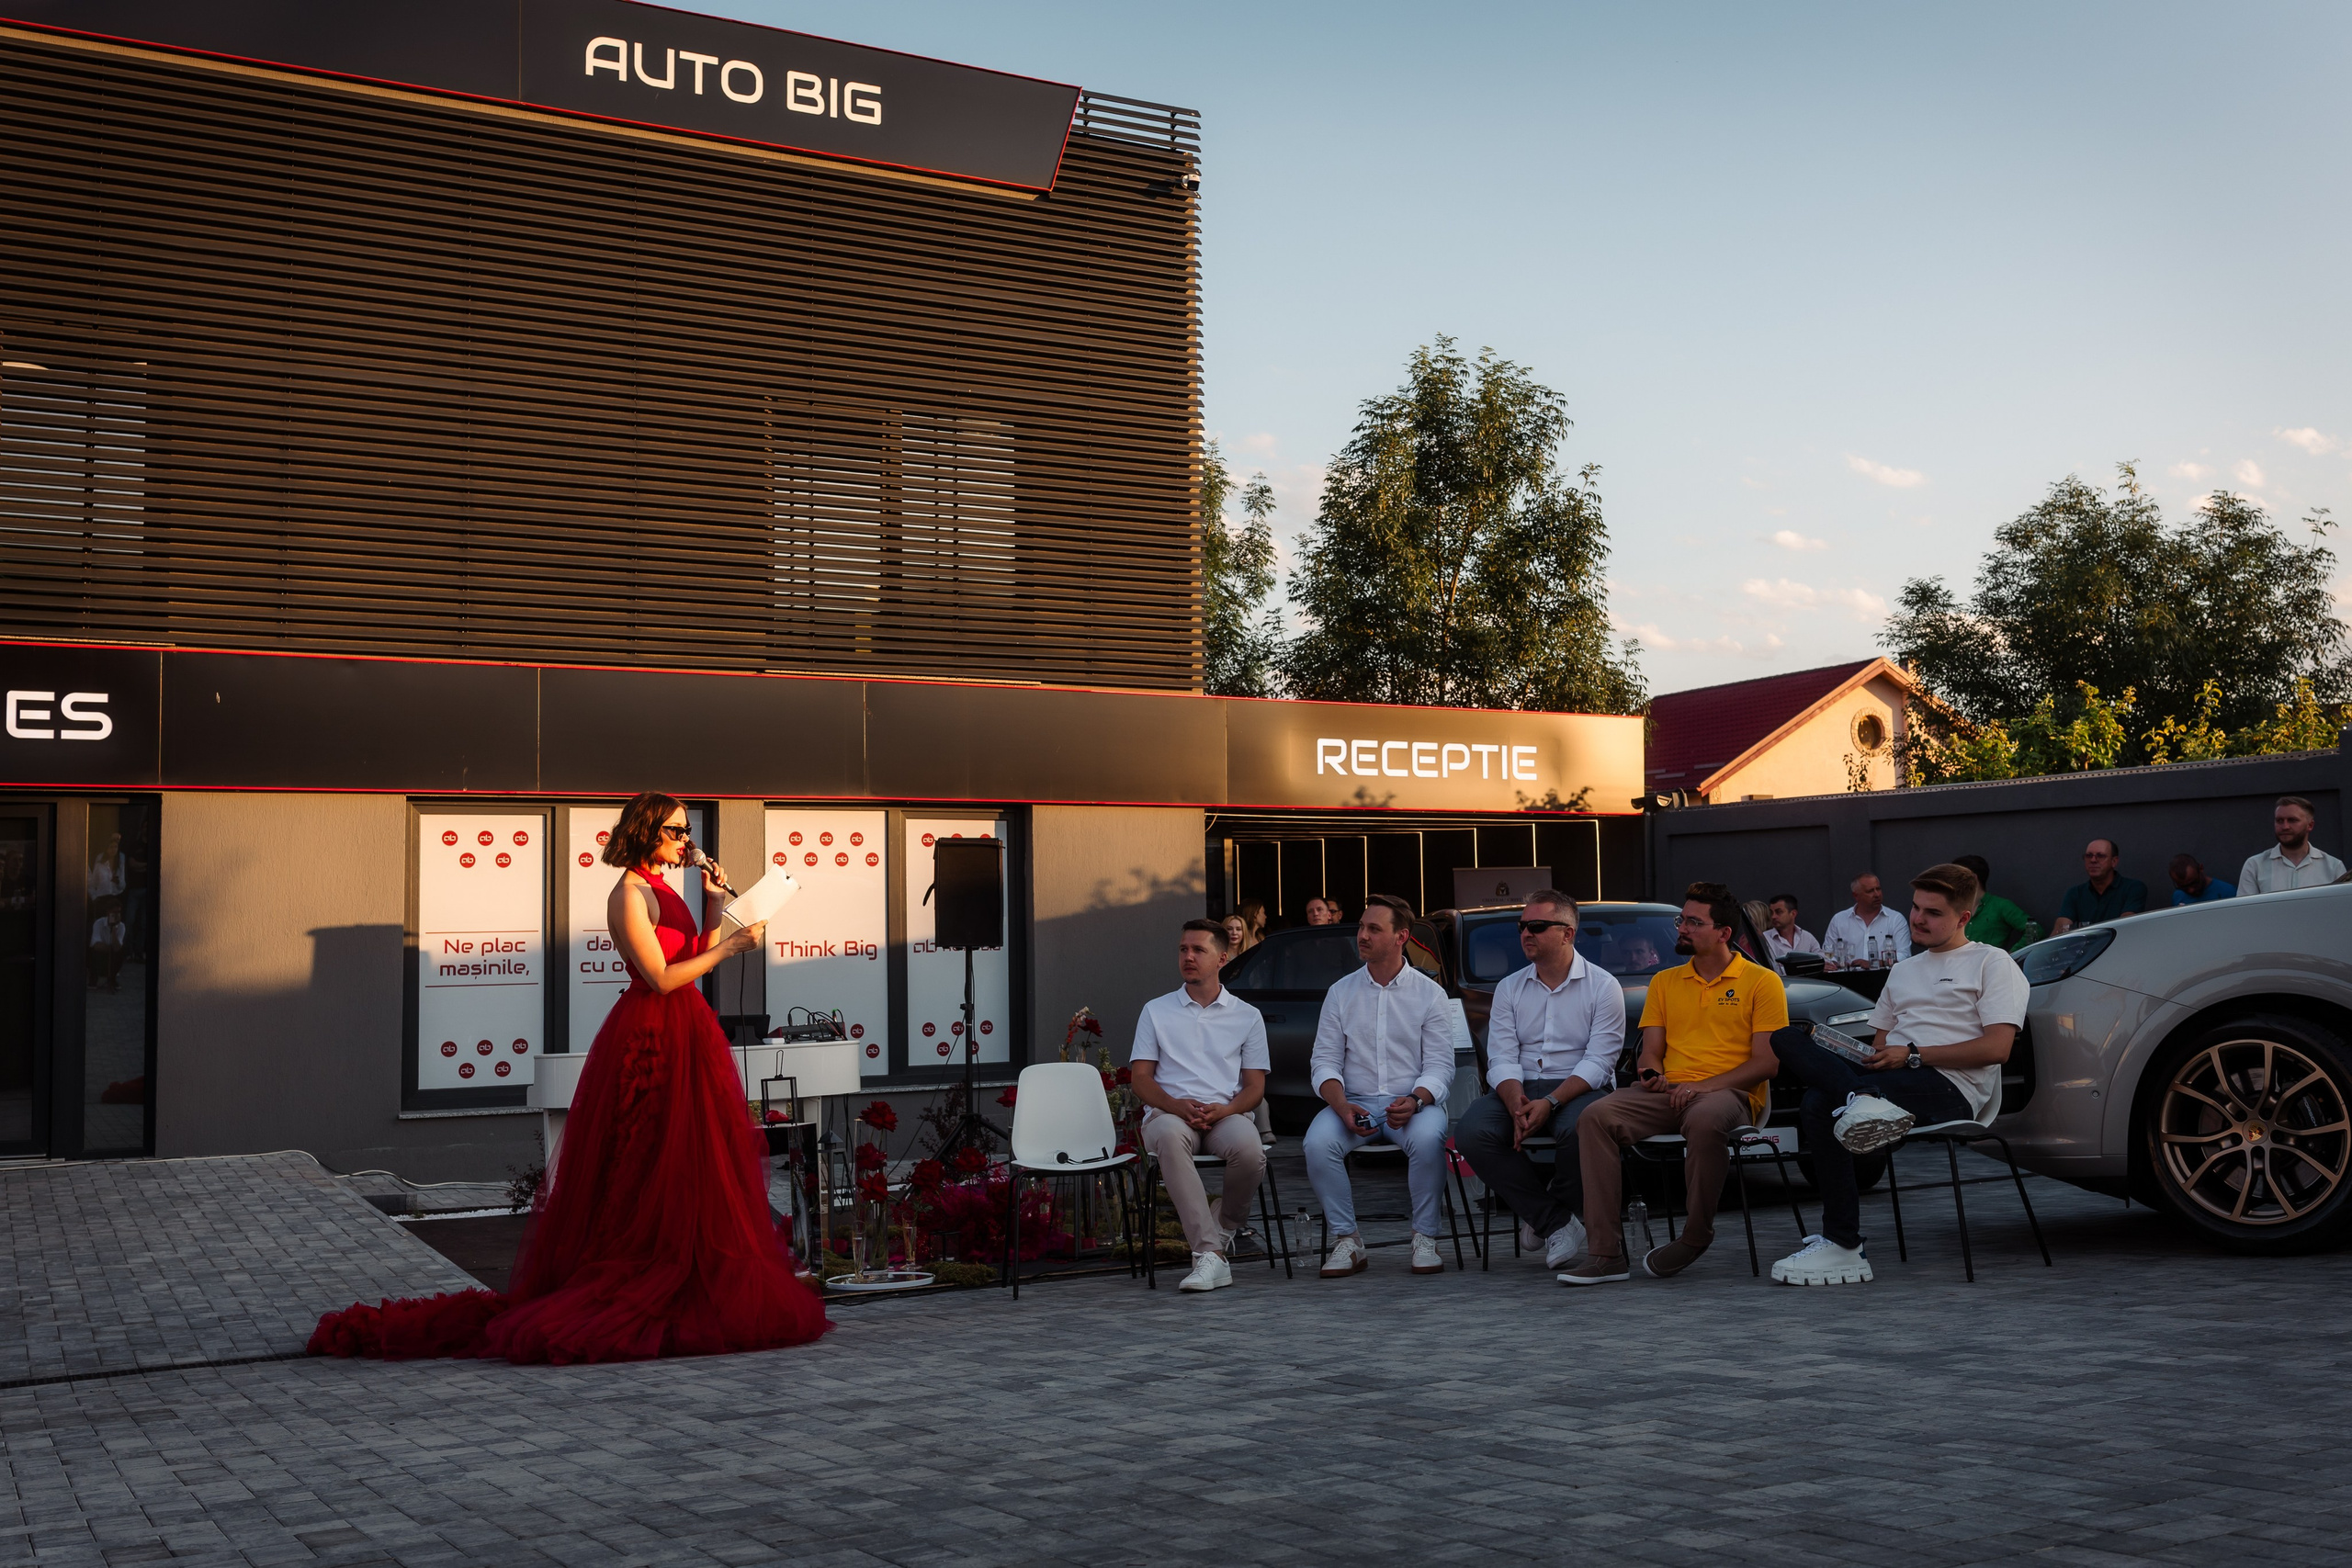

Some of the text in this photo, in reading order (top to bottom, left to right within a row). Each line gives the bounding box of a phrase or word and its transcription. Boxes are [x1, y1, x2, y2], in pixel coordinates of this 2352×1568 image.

[585, 36, 882, 126] AUTO BIG
[6, 690, 113, 740] ES
[1317, 738, 1538, 781] RECEPTIE
[445, 937, 526, 956] Ne plac
[775, 939, 877, 961] Think Big
[440, 959, 529, 979] mașinile,
[580, 961, 605, 973] cu
